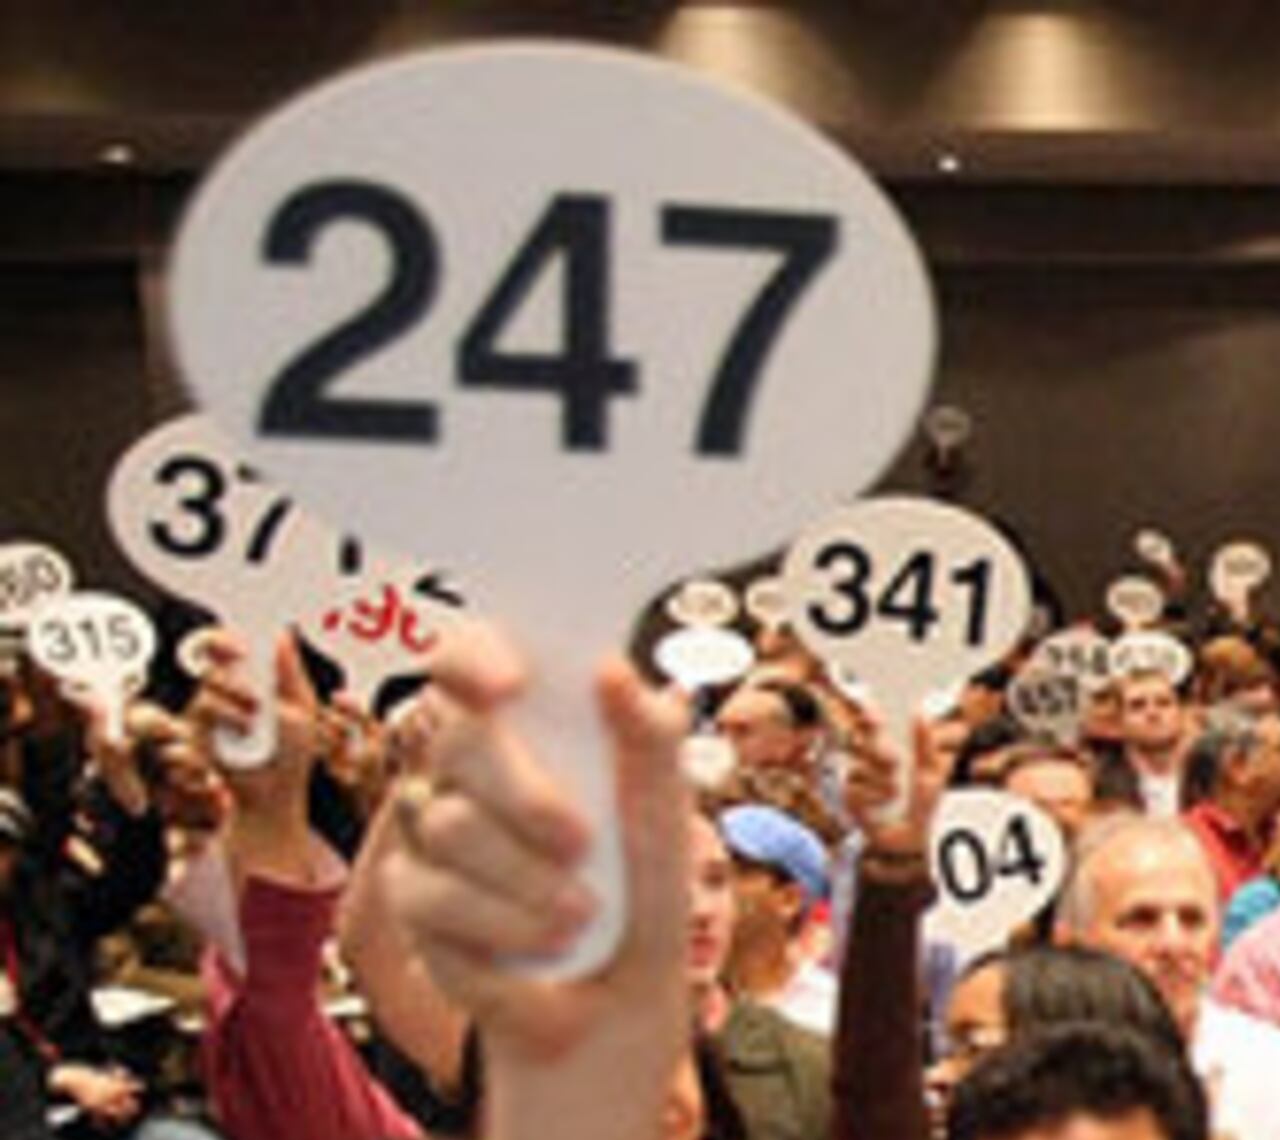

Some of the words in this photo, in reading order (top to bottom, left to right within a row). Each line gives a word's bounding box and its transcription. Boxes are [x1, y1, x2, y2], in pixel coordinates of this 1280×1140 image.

[255, 177, 840, 459] 247
[39, 613, 142, 666] 315
[806, 540, 993, 649] 341
[936, 812, 1045, 904] 04
